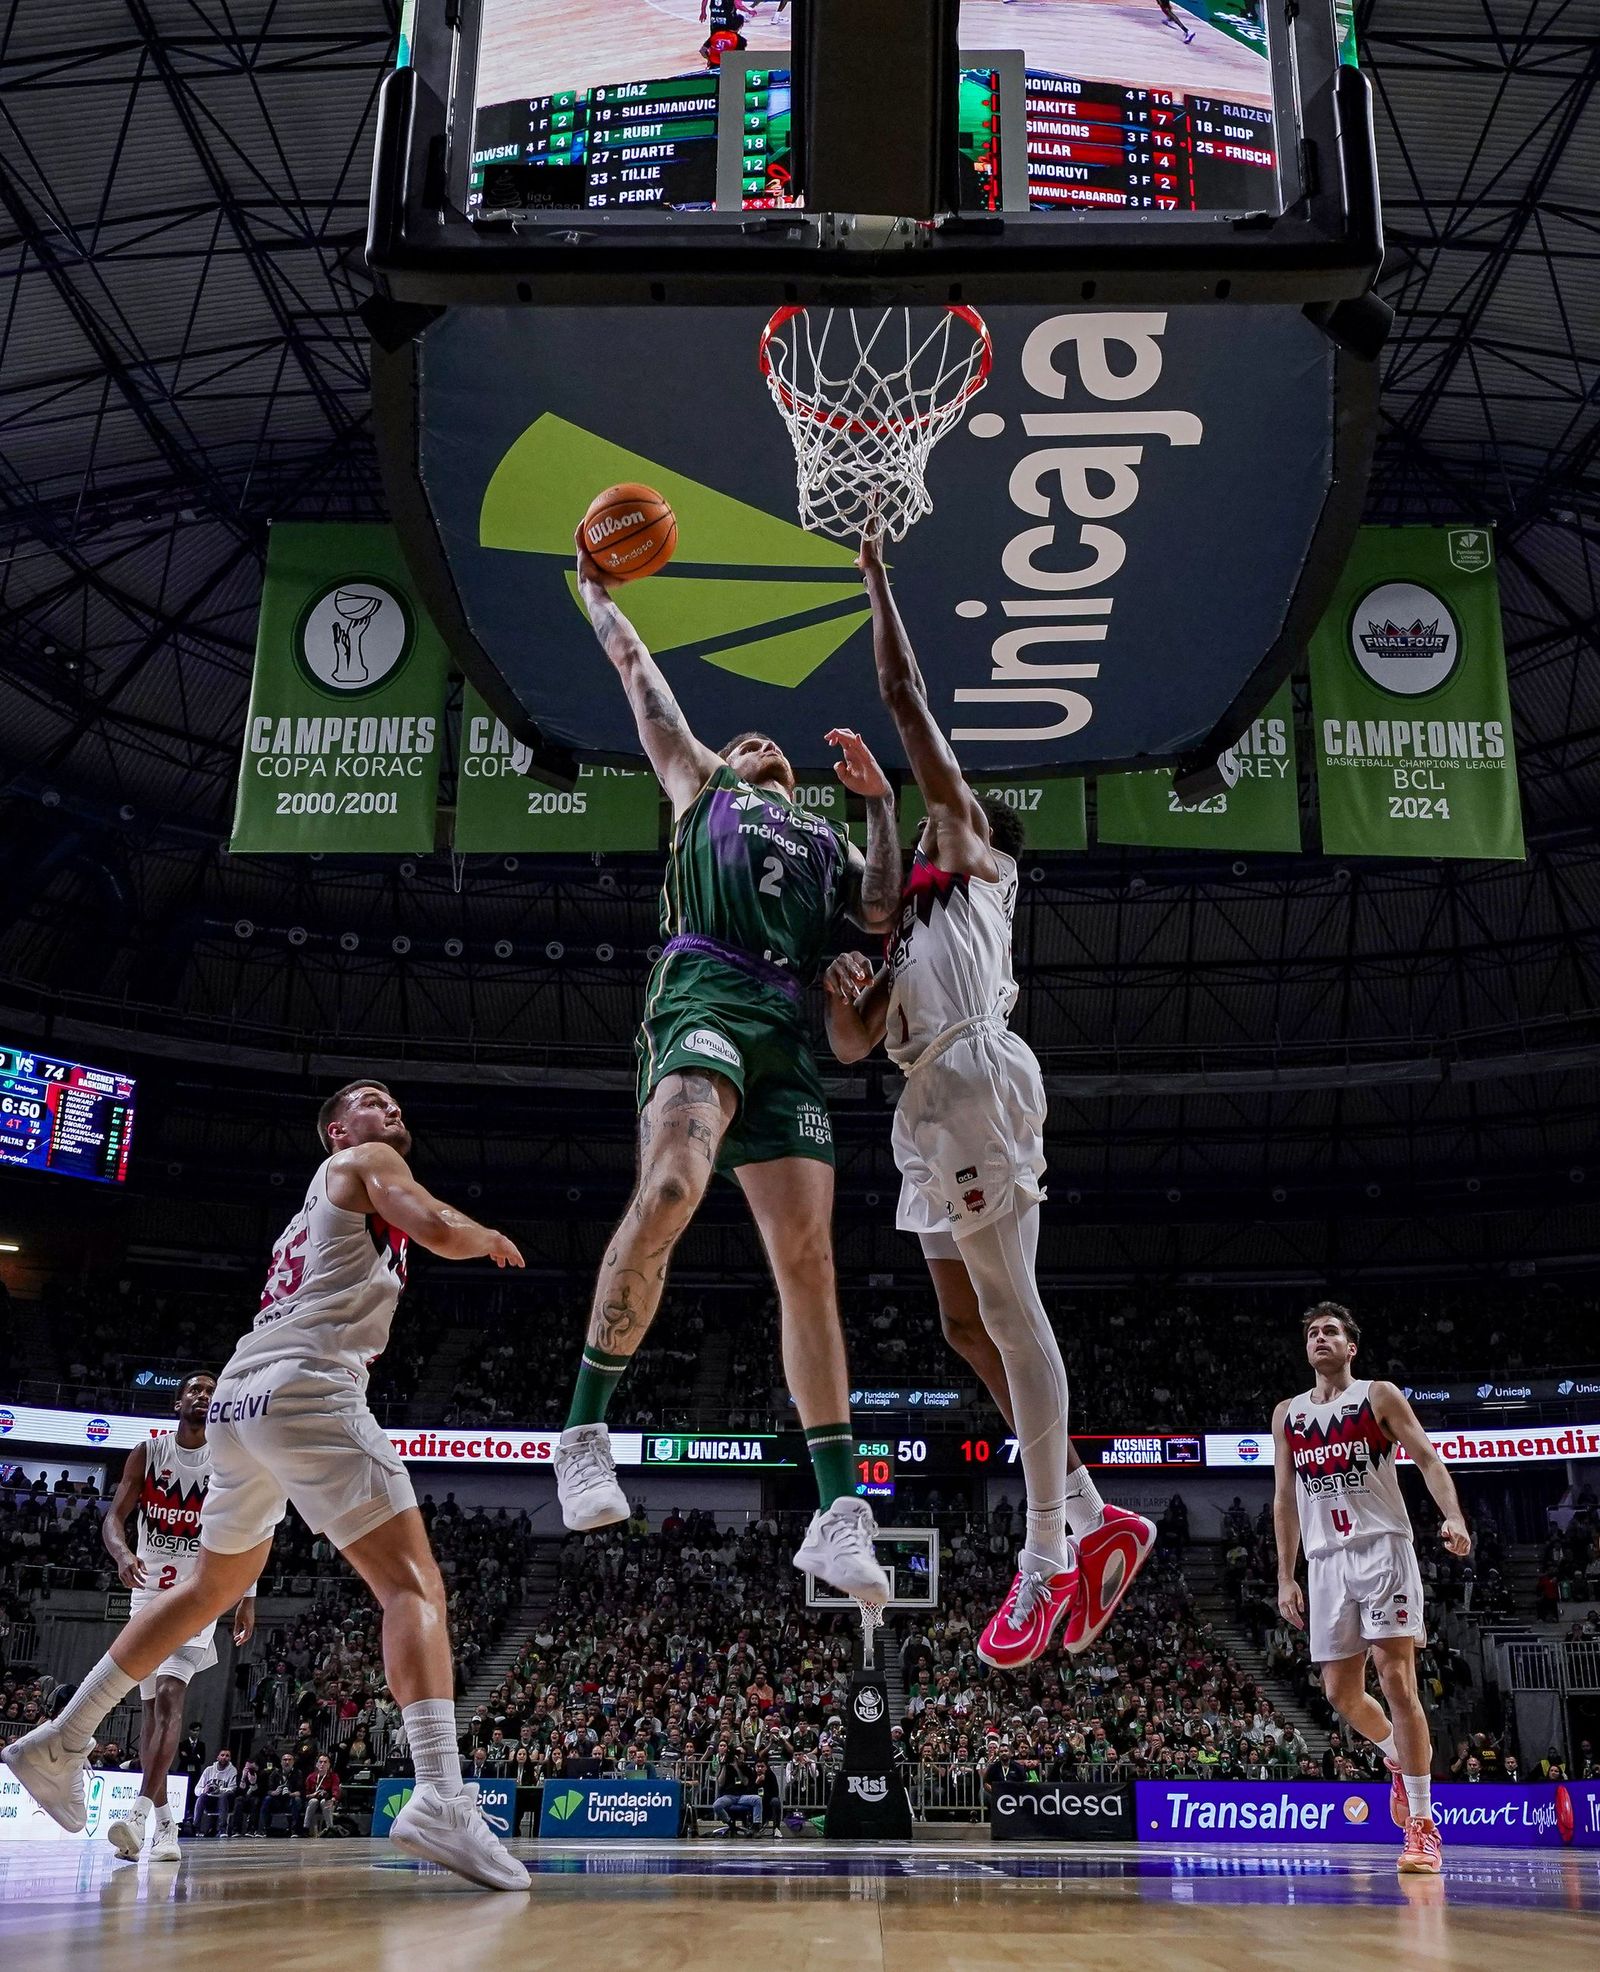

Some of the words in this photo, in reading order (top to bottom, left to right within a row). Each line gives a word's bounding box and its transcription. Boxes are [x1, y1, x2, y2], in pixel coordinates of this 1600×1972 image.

[752, 75, 761, 86] 5
[1025, 79, 1082, 94] HOWARD
[596, 88, 605, 101] 9
[617, 83, 648, 99] DÍAZ
[1125, 90, 1134, 100] 4
[1138, 92, 1147, 101] F
[1153, 93, 1171, 105] 16
[541, 98, 549, 110] F
[559, 95, 569, 106] 6
[752, 96, 758, 107] 1
[1195, 99, 1211, 112] 17
[595, 109, 611, 121] 19
[621, 98, 717, 118] SULEJMANOVIC
[1126, 111, 1133, 121] 1
[1139, 112, 1148, 122] F
[528, 121, 534, 132] 1
[539, 119, 548, 129] F
[558, 115, 567, 127] 2
[751, 117, 760, 128] 9
[1157, 114, 1167, 125] 7
[593, 130, 610, 144] 21
[623, 123, 664, 139] RUBIT
[1026, 120, 1090, 138] SIMMONS
[1196, 120, 1213, 133] 18
[1224, 125, 1254, 141] DIOP
[556, 137, 565, 148] 4
[746, 138, 764, 149] 18
[1127, 132, 1136, 142] 3
[1140, 133, 1149, 143] F
[1154, 135, 1173, 147] 16
[526, 142, 534, 153] 4
[537, 140, 547, 151] F
[1027, 142, 1072, 157] VILLAR
[1196, 141, 1214, 154] 25
[1225, 145, 1272, 166] FRISCH
[592, 151, 610, 165] 27
[621, 144, 675, 161] DUARTE
[1128, 154, 1137, 163] 0
[1141, 154, 1150, 164] F
[745, 159, 763, 171] 12
[1159, 156, 1170, 168] 4
[590, 172, 608, 186] 33
[621, 166, 661, 182] TILLIE
[1028, 164, 1088, 180] OMORUYI
[748, 181, 758, 193] 4
[1129, 175, 1138, 185] 3
[1142, 176, 1151, 185] F
[1161, 178, 1171, 189] 2
[588, 194, 607, 208] 55
[618, 187, 664, 204] PERRY
[1028, 185, 1128, 205] UWAWU-CABARROT
[1130, 196, 1139, 207] 3
[1143, 197, 1152, 207] F
[1158, 199, 1176, 211] 17
[587, 510, 646, 545] Wilson
[950, 311, 1203, 741] Unicaja
[1364, 637, 1406, 647] FINAL
[1407, 637, 1444, 647] FOUR
[250, 716, 436, 755] CAMPEONES
[1323, 719, 1505, 759] CAMPEONES
[256, 756, 327, 778] COPA
[335, 756, 423, 777] KORAC
[464, 756, 521, 777] COP
[1239, 758, 1290, 778] REY
[1326, 757, 1394, 768] BASKETBALL
[1399, 759, 1460, 769] CHAMPIONS
[1465, 760, 1507, 769] LEAGUE
[1394, 768, 1445, 790] BCL
[276, 792, 398, 815] 2000/2001
[528, 792, 587, 814] 2005
[792, 786, 835, 808] 006
[1388, 796, 1450, 820] 2024
[758, 856, 784, 898] 2
[15, 1055, 35, 1073] VS
[44, 1064, 65, 1081] 74
[86, 1071, 115, 1085] KOSNER
[14, 1083, 39, 1095] Unicaja
[78, 1078, 113, 1093] BASKONIA
[1, 1097, 40, 1119] 6:50
[6, 1118, 22, 1129] 4T
[0, 1135, 24, 1147] FALTAS
[25, 1138, 37, 1151] 5
[958, 1173, 974, 1182] acb
[864, 1391, 900, 1399] Fundación
[923, 1391, 959, 1399] Fundación
[1414, 1390, 1450, 1401] Unicaja
[1495, 1386, 1531, 1398] Unicaja
[864, 1398, 890, 1406] Unicaja
[923, 1399, 949, 1407] Unicaja
[687, 1441, 763, 1460] UNICAJA
[858, 1444, 889, 1456] 6:50
[897, 1440, 927, 1462] 50
[961, 1440, 990, 1462] 10
[1004, 1439, 1020, 1464] 7
[1113, 1438, 1162, 1451] KOSNER
[1102, 1451, 1163, 1464] BASKONIA
[1293, 1436, 1370, 1468] kingroyal
[858, 1461, 889, 1483] 10
[867, 1487, 891, 1496] Unicaja
[1331, 1508, 1353, 1537] 4
[158, 1564, 178, 1590] 2
[858, 1705, 878, 1717] Risi
[847, 1776, 889, 1799] Risi
[588, 1791, 672, 1808] Fundación
[996, 1788, 1123, 1816] endesa
[587, 1807, 648, 1827] Unicaja
[1166, 1793, 1335, 1830] Transaher
[1430, 1801, 1519, 1826] Smart
